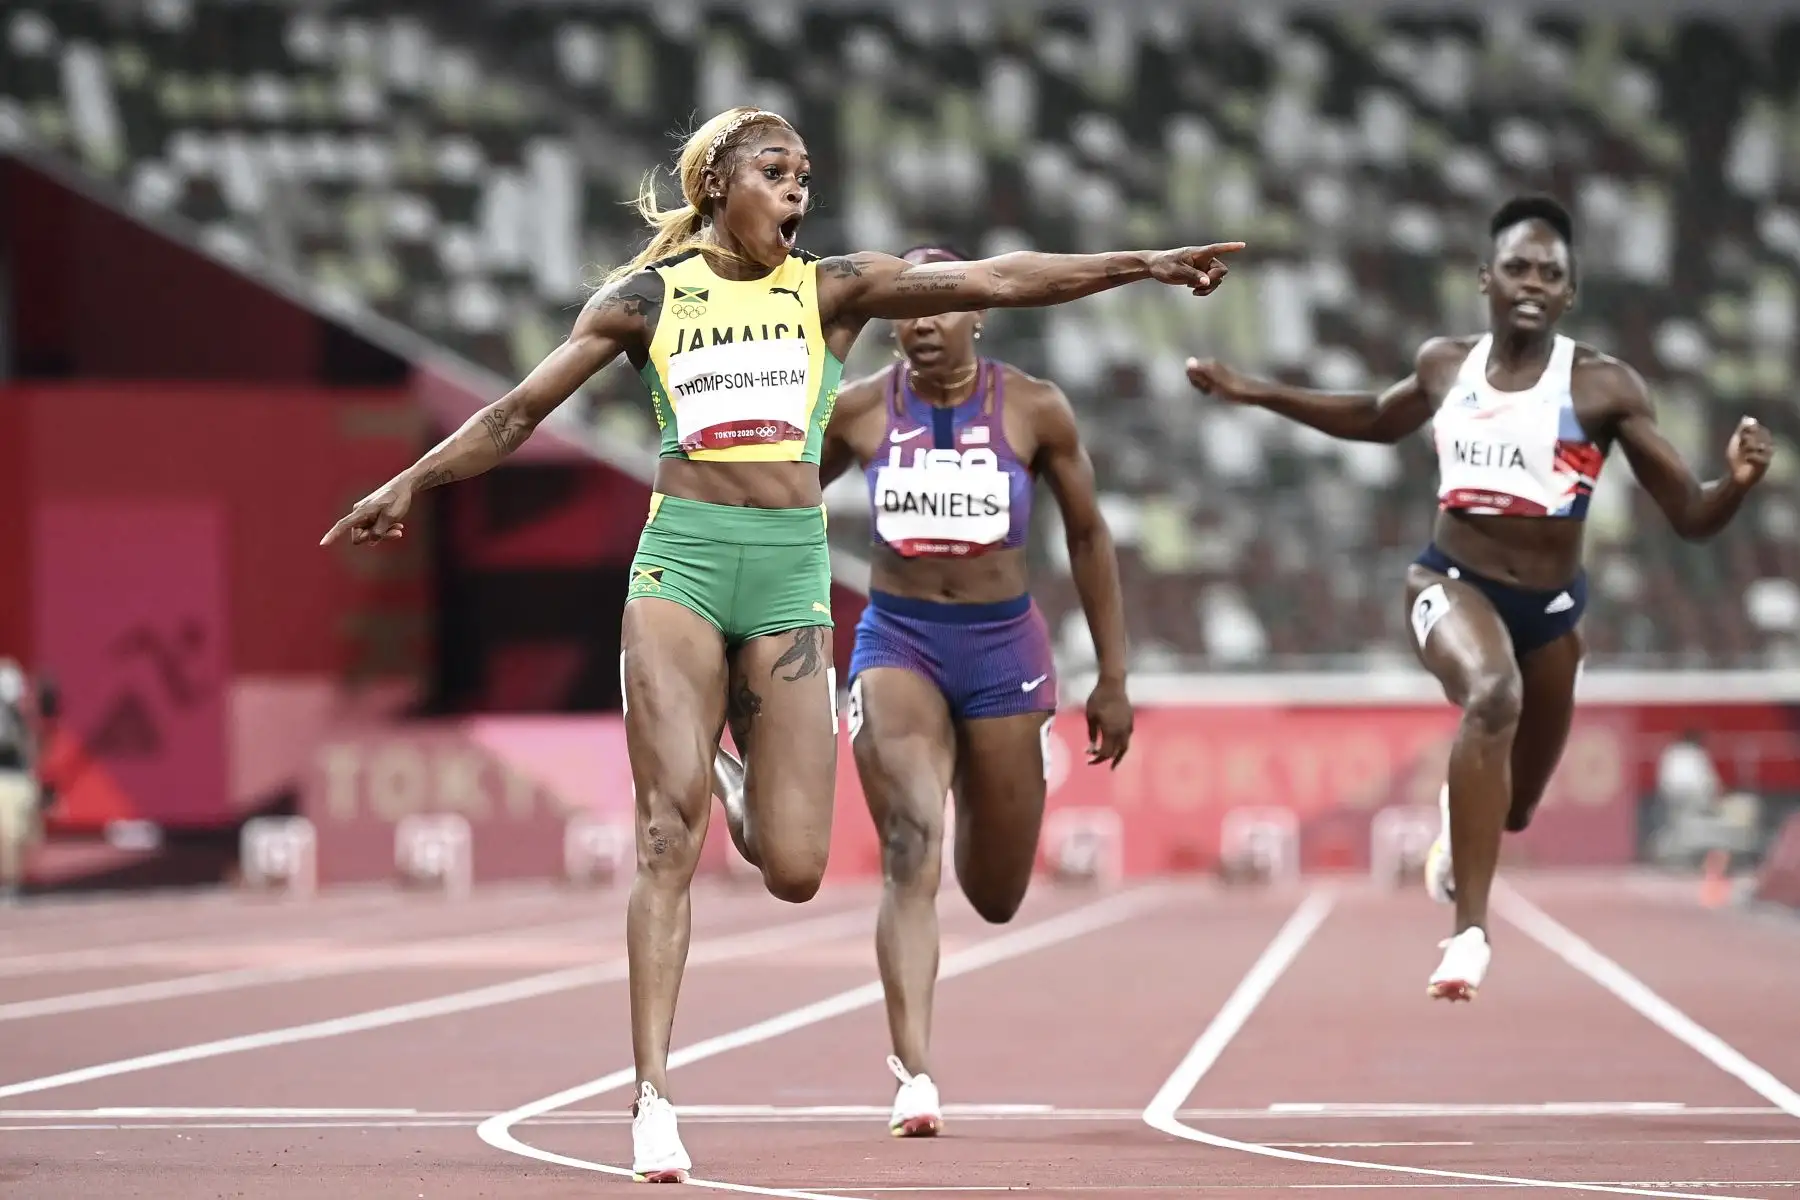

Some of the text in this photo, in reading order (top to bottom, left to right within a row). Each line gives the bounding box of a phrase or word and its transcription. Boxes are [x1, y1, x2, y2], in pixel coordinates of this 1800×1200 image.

[669, 323, 810, 357] JAMAICA
[714, 429, 754, 439] TOKYO 2020
[1454, 440, 1526, 470] NEITA
[884, 489, 1000, 517] DANIELS
